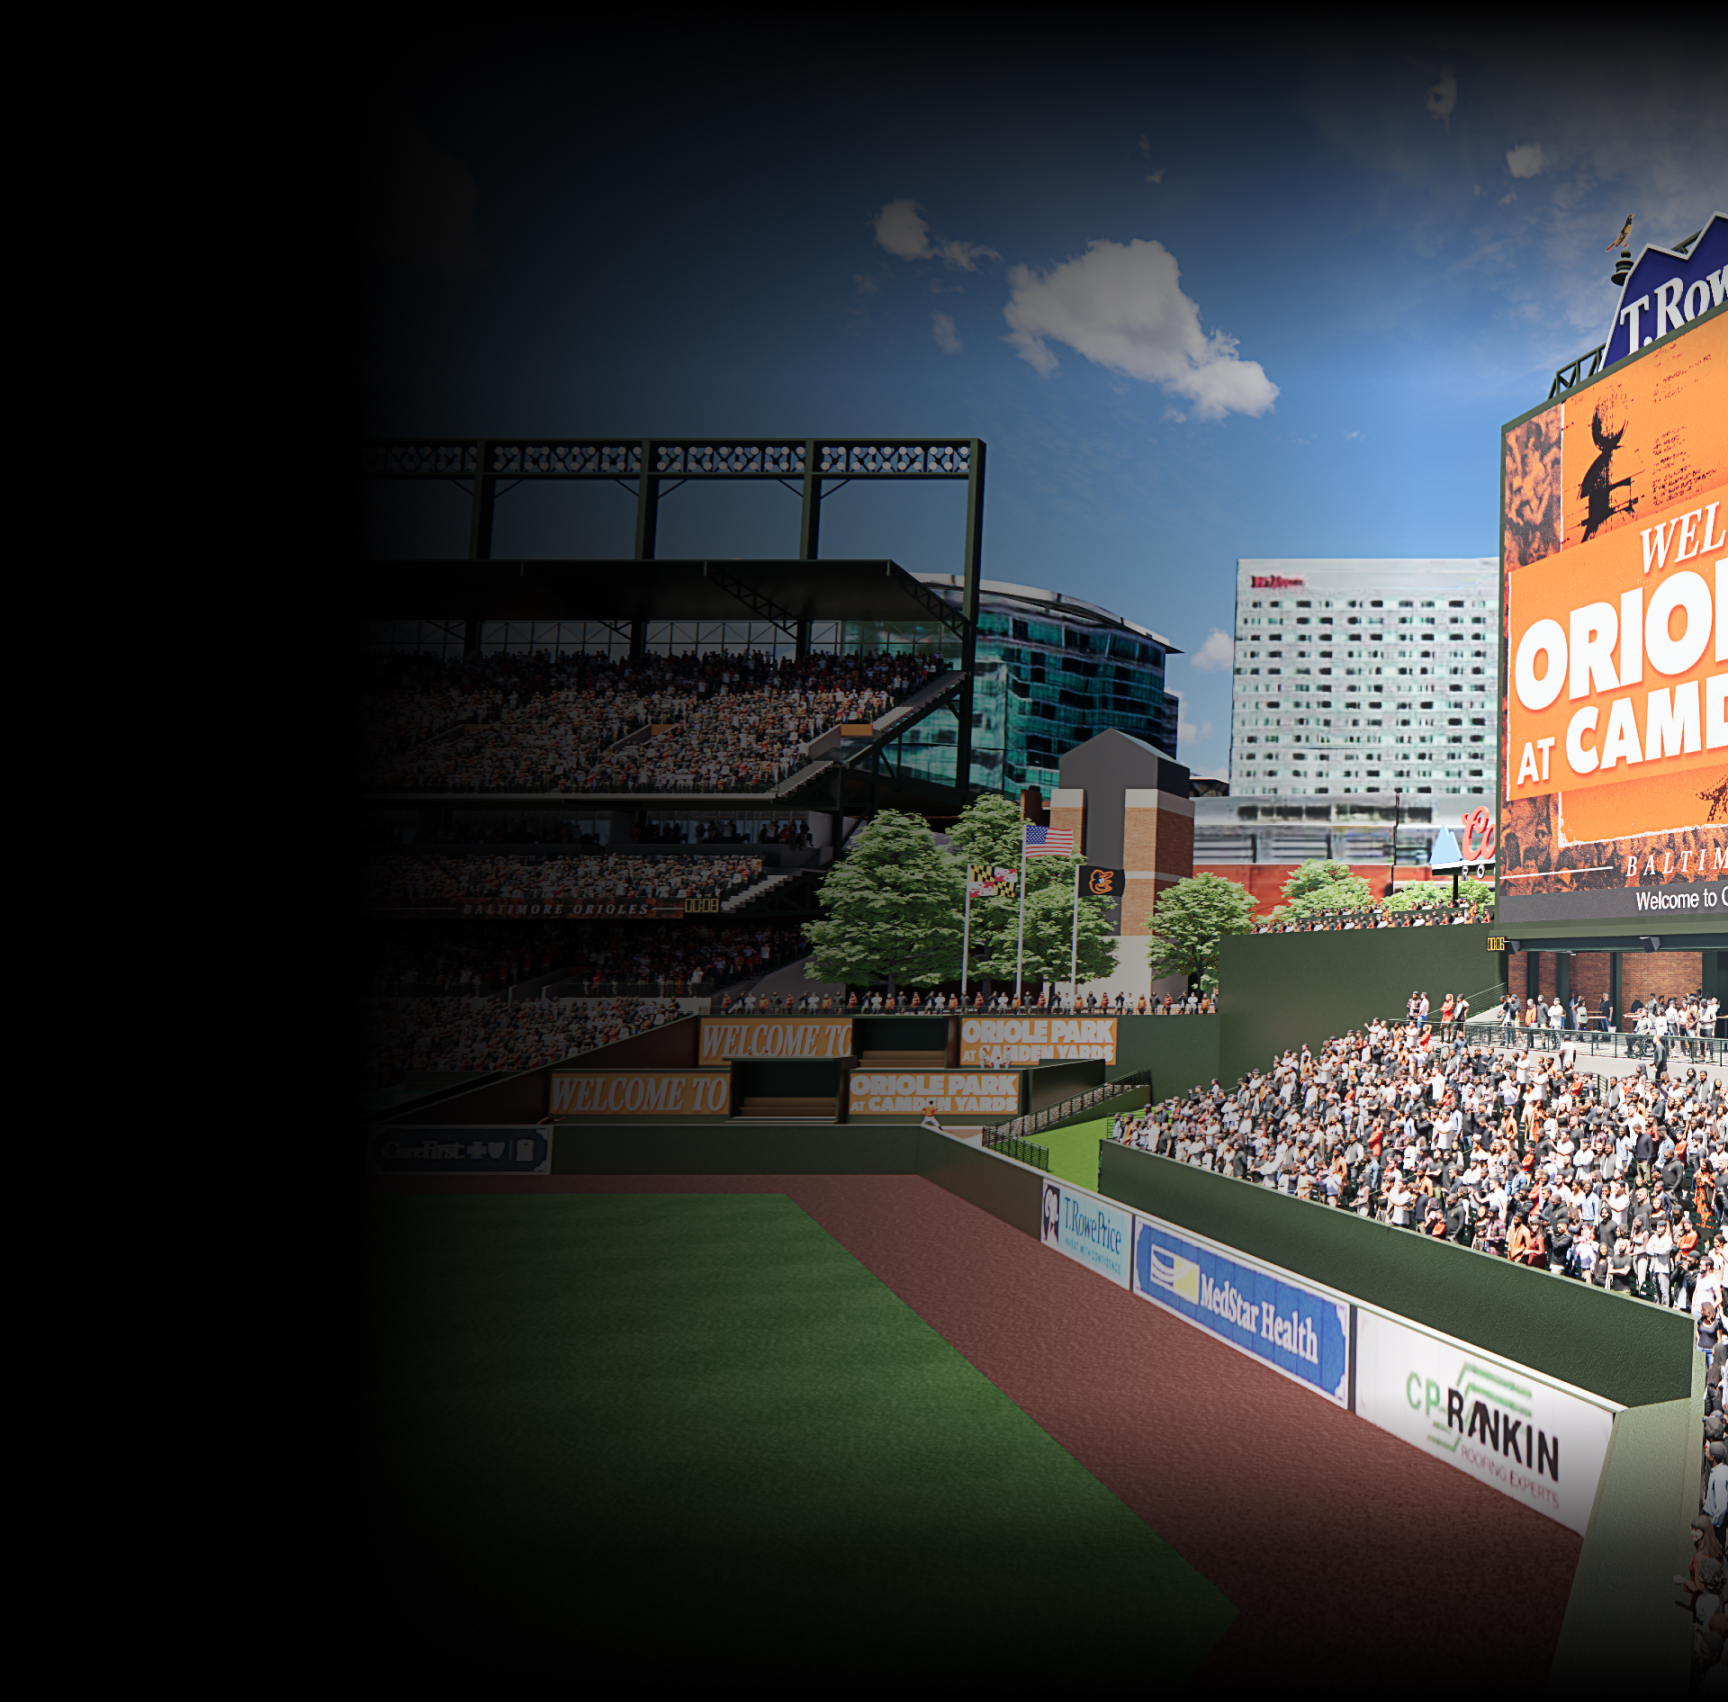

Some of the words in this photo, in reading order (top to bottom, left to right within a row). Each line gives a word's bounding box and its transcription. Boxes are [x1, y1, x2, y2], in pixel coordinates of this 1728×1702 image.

[1516, 737, 1555, 786] AT
[462, 904, 564, 915] BALTIMORE
[572, 903, 649, 915] ORIOLES
[1635, 888, 1700, 912] Welcome
[1703, 887, 1717, 908] to
[702, 1025, 821, 1058] WELCOME
[824, 1024, 852, 1057] TO
[961, 1019, 1049, 1044] ORIOLE
[1050, 1019, 1115, 1044] PARK
[962, 1049, 977, 1062] AT
[1053, 1045, 1115, 1062] YARDS
[551, 1077, 686, 1111] WELCOME
[691, 1077, 728, 1111] TO
[849, 1075, 945, 1096] ORIOLE
[947, 1075, 1019, 1096] PARK
[850, 1101, 866, 1112] AT
[952, 1097, 1018, 1112] YARDS
[1200, 1273, 1260, 1334] MedStar
[1260, 1301, 1319, 1365] Health
[1447, 1387, 1559, 1483] RANKIN
[1461, 1445, 1507, 1482] ROOFING
[1509, 1470, 1559, 1510] EXPERTS
